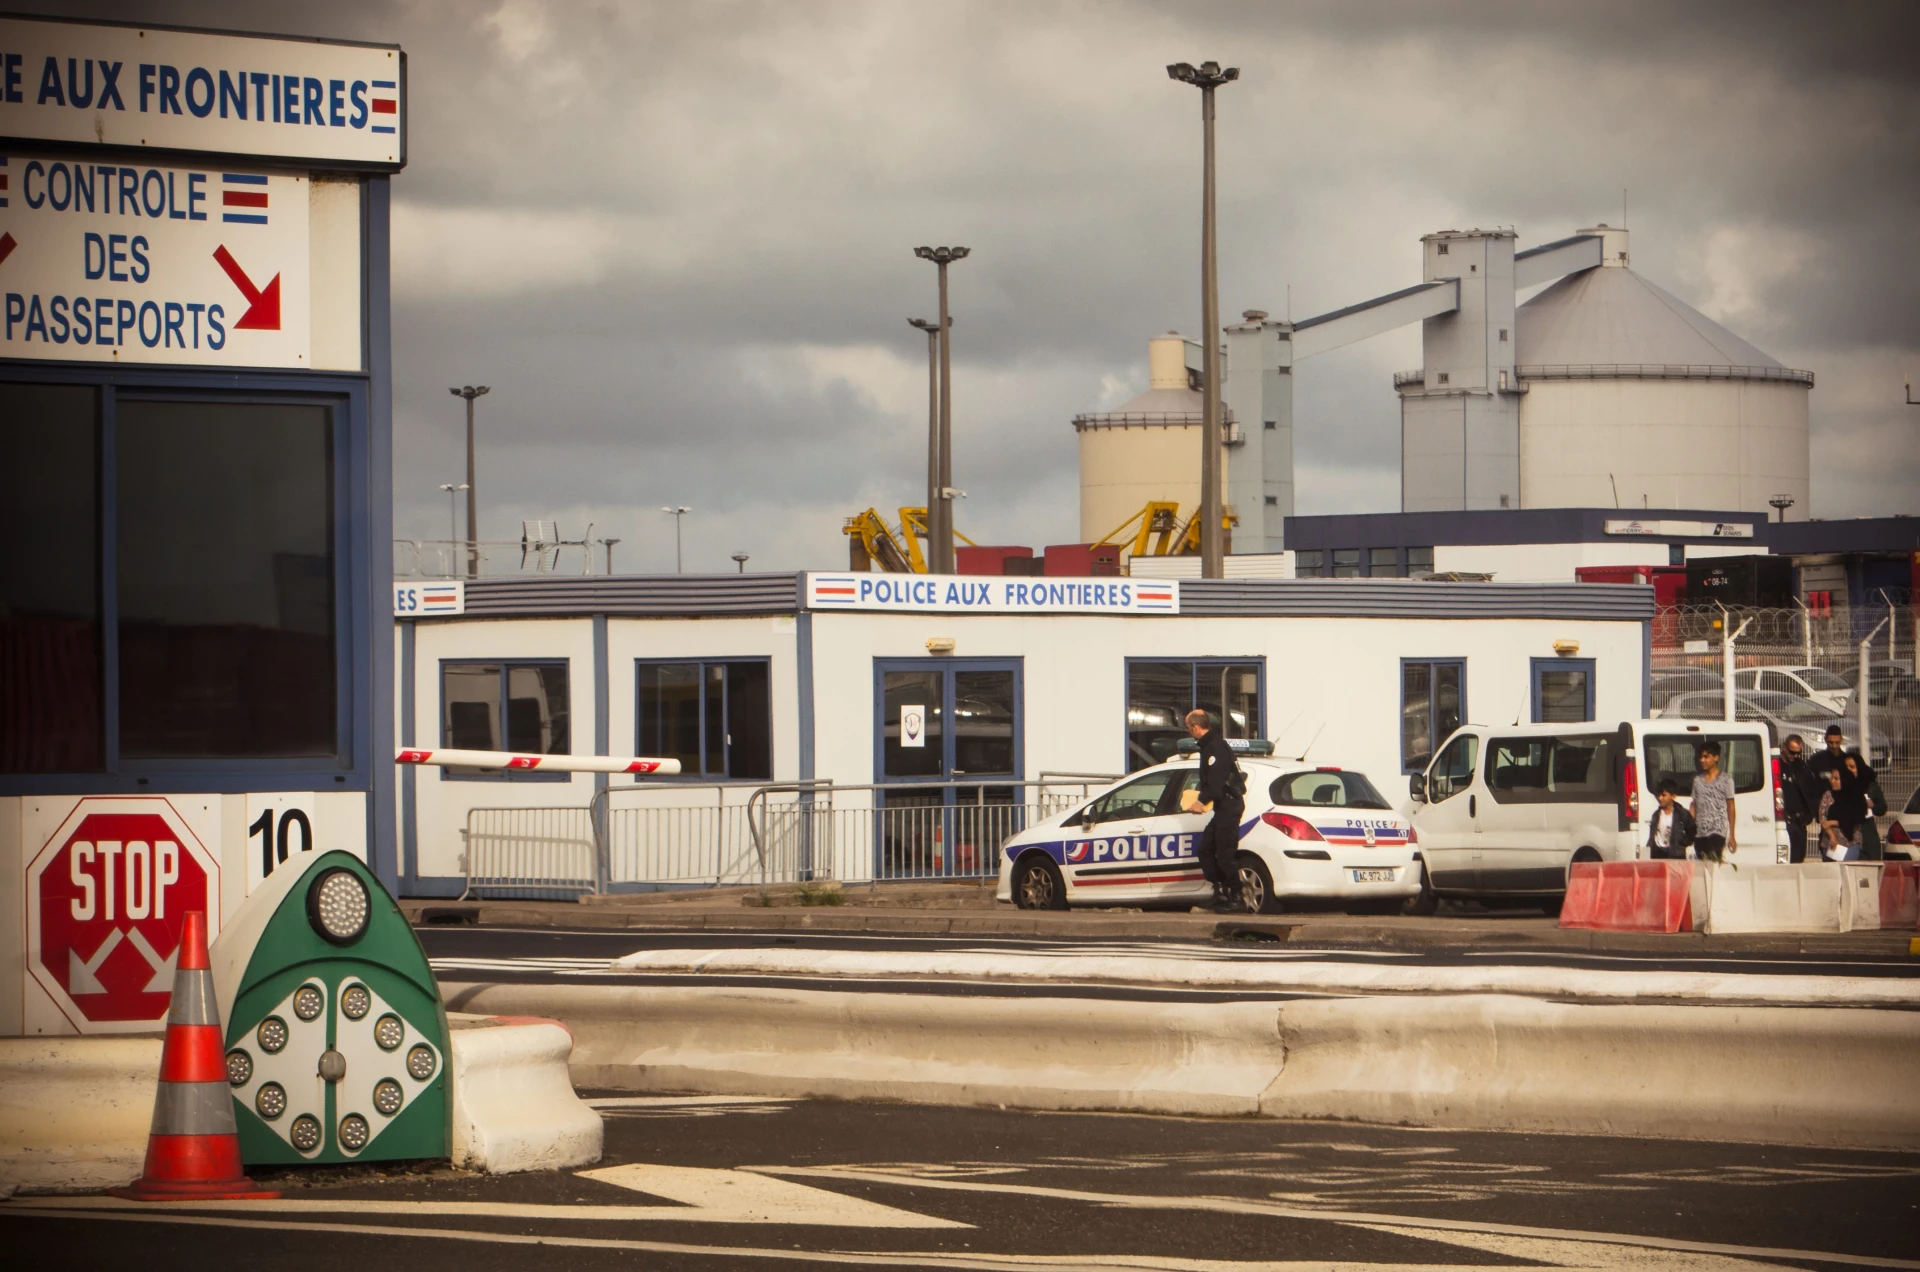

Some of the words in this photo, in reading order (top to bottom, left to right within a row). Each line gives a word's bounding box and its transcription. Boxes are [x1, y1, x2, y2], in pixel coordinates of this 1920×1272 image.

[0, 53, 23, 103] E
[37, 56, 125, 111] AUX
[139, 64, 368, 129] FRONTIERES
[23, 160, 208, 222] CONTROLE
[84, 232, 150, 284] DES
[6, 293, 226, 351] PASSEPORTS
[395, 589, 417, 611] ES
[860, 580, 937, 604] POLICE
[945, 583, 991, 605] AUX
[1005, 583, 1132, 607] FRONTIERES
[249, 808, 313, 879] 10
[1093, 834, 1193, 862] POLICE
[1346, 819, 1388, 829] POLICE
[70, 840, 179, 921] STOP
